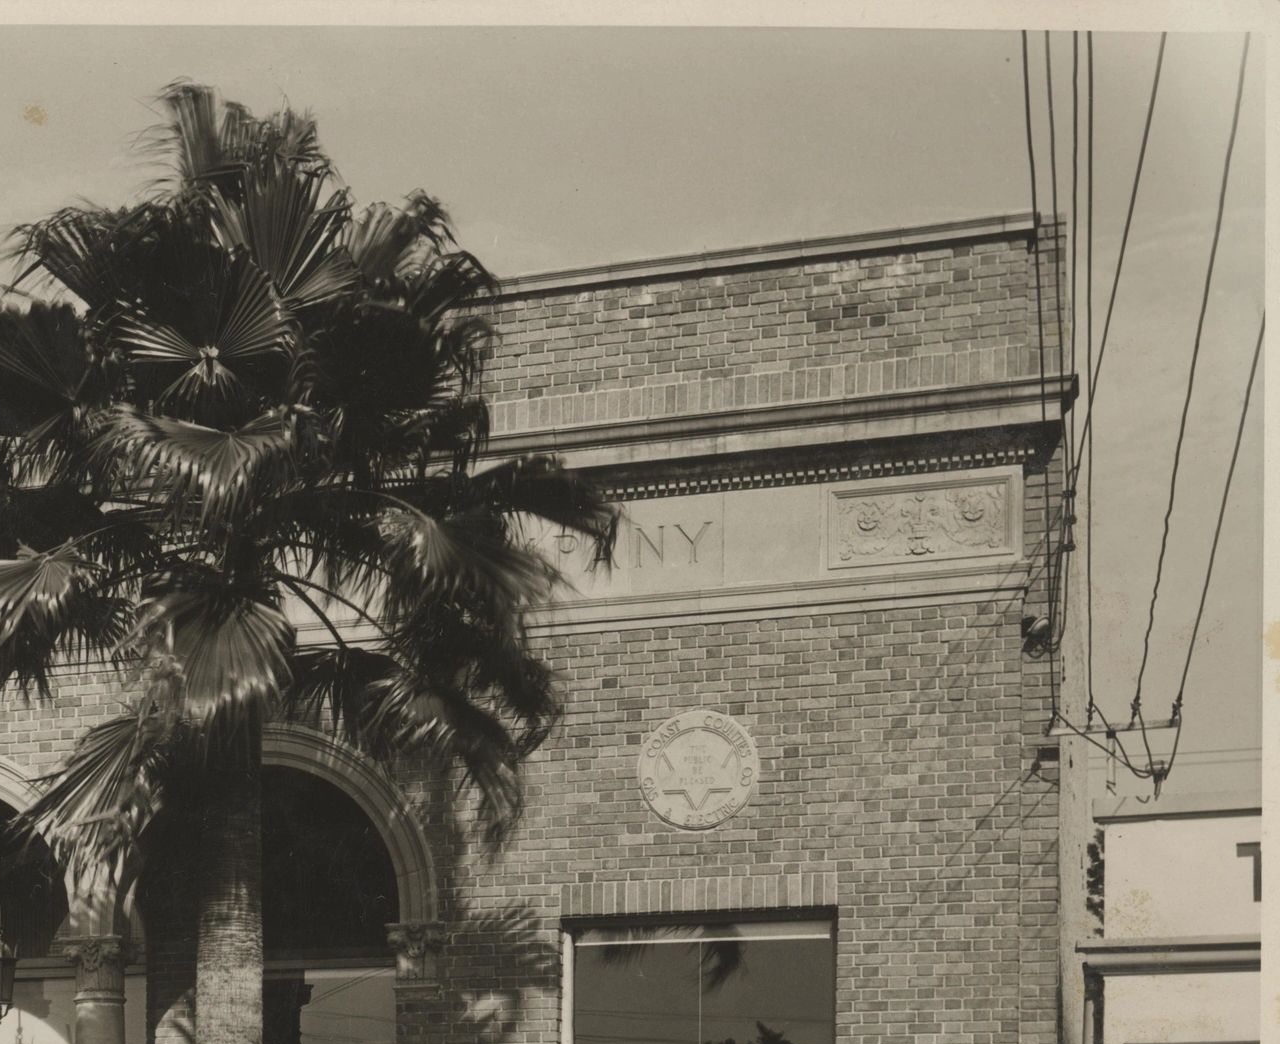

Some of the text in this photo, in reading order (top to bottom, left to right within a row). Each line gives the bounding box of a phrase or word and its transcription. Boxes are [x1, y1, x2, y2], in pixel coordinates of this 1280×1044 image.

[526, 521, 714, 577] PANY
[647, 715, 752, 758] COAST COUNTIES
[642, 777, 659, 801] GAS
[683, 797, 740, 825] ELECTRIC
[680, 776, 716, 786] PLEASED
